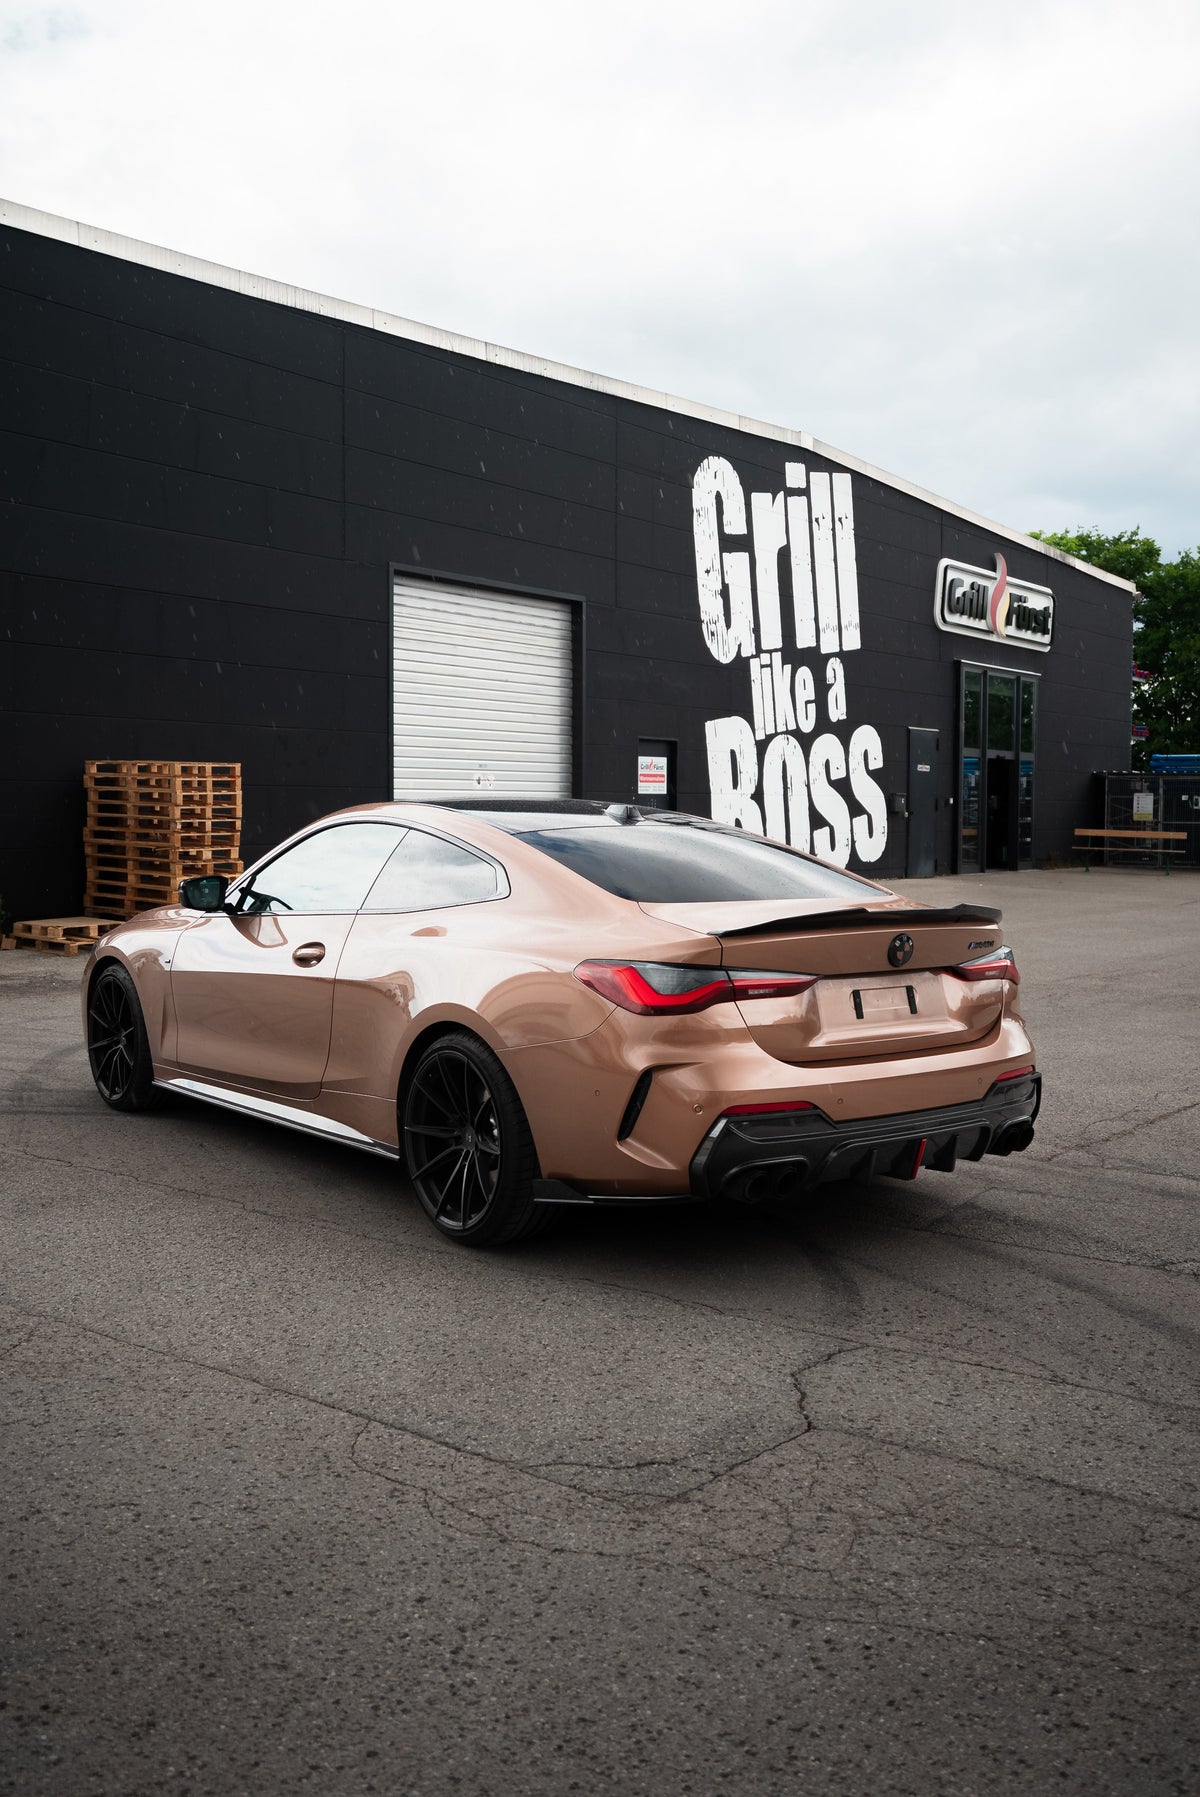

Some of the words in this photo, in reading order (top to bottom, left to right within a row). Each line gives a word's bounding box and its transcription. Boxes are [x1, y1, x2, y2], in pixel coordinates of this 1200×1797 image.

[692, 455, 861, 664] Grill
[949, 577, 989, 620] Grill
[1005, 592, 1051, 635] Fürst
[750, 651, 816, 740] like
[826, 657, 847, 722] a
